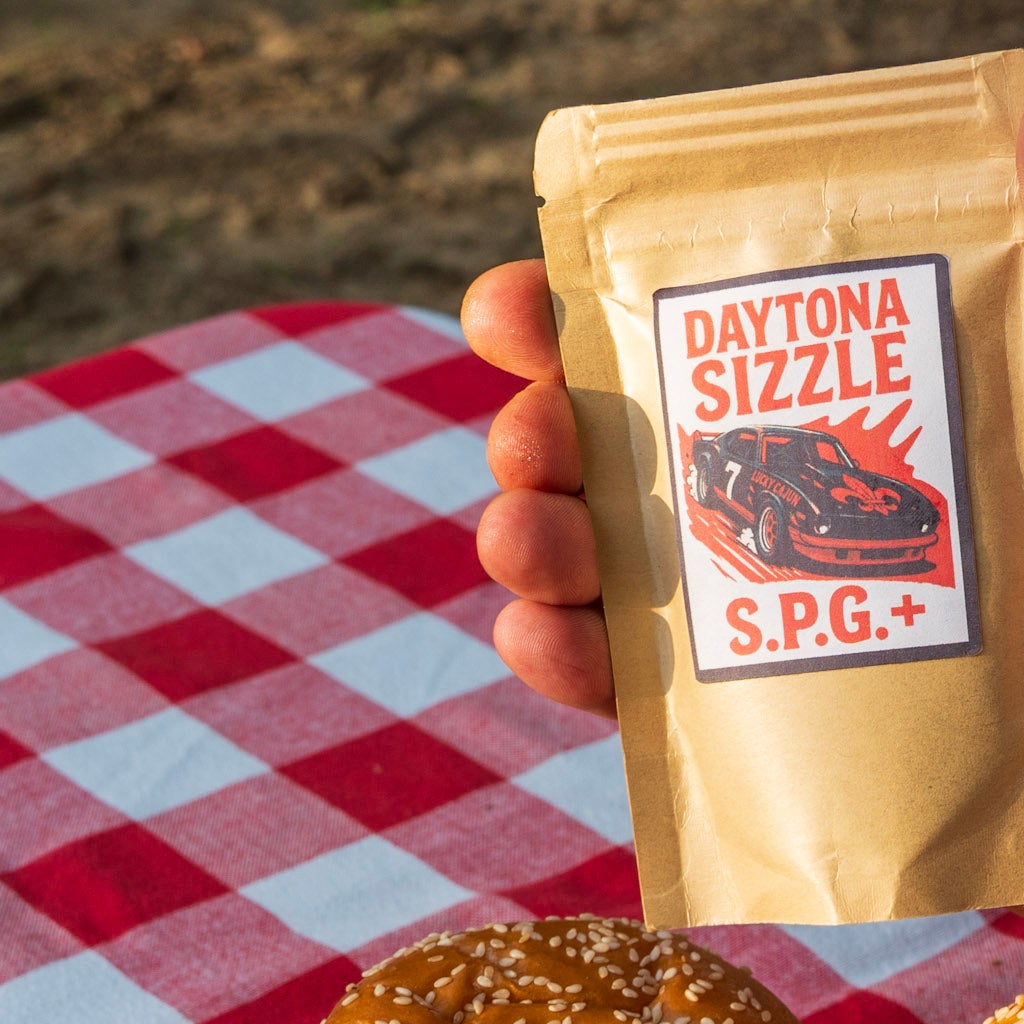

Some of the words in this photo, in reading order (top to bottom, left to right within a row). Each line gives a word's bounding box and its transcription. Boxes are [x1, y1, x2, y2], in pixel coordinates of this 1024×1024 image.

[683, 278, 910, 359] DAYTONA
[691, 330, 911, 422] SIZZLE
[725, 460, 742, 500] 7
[751, 469, 777, 490] LUCKY
[772, 481, 801, 507] CAJUN
